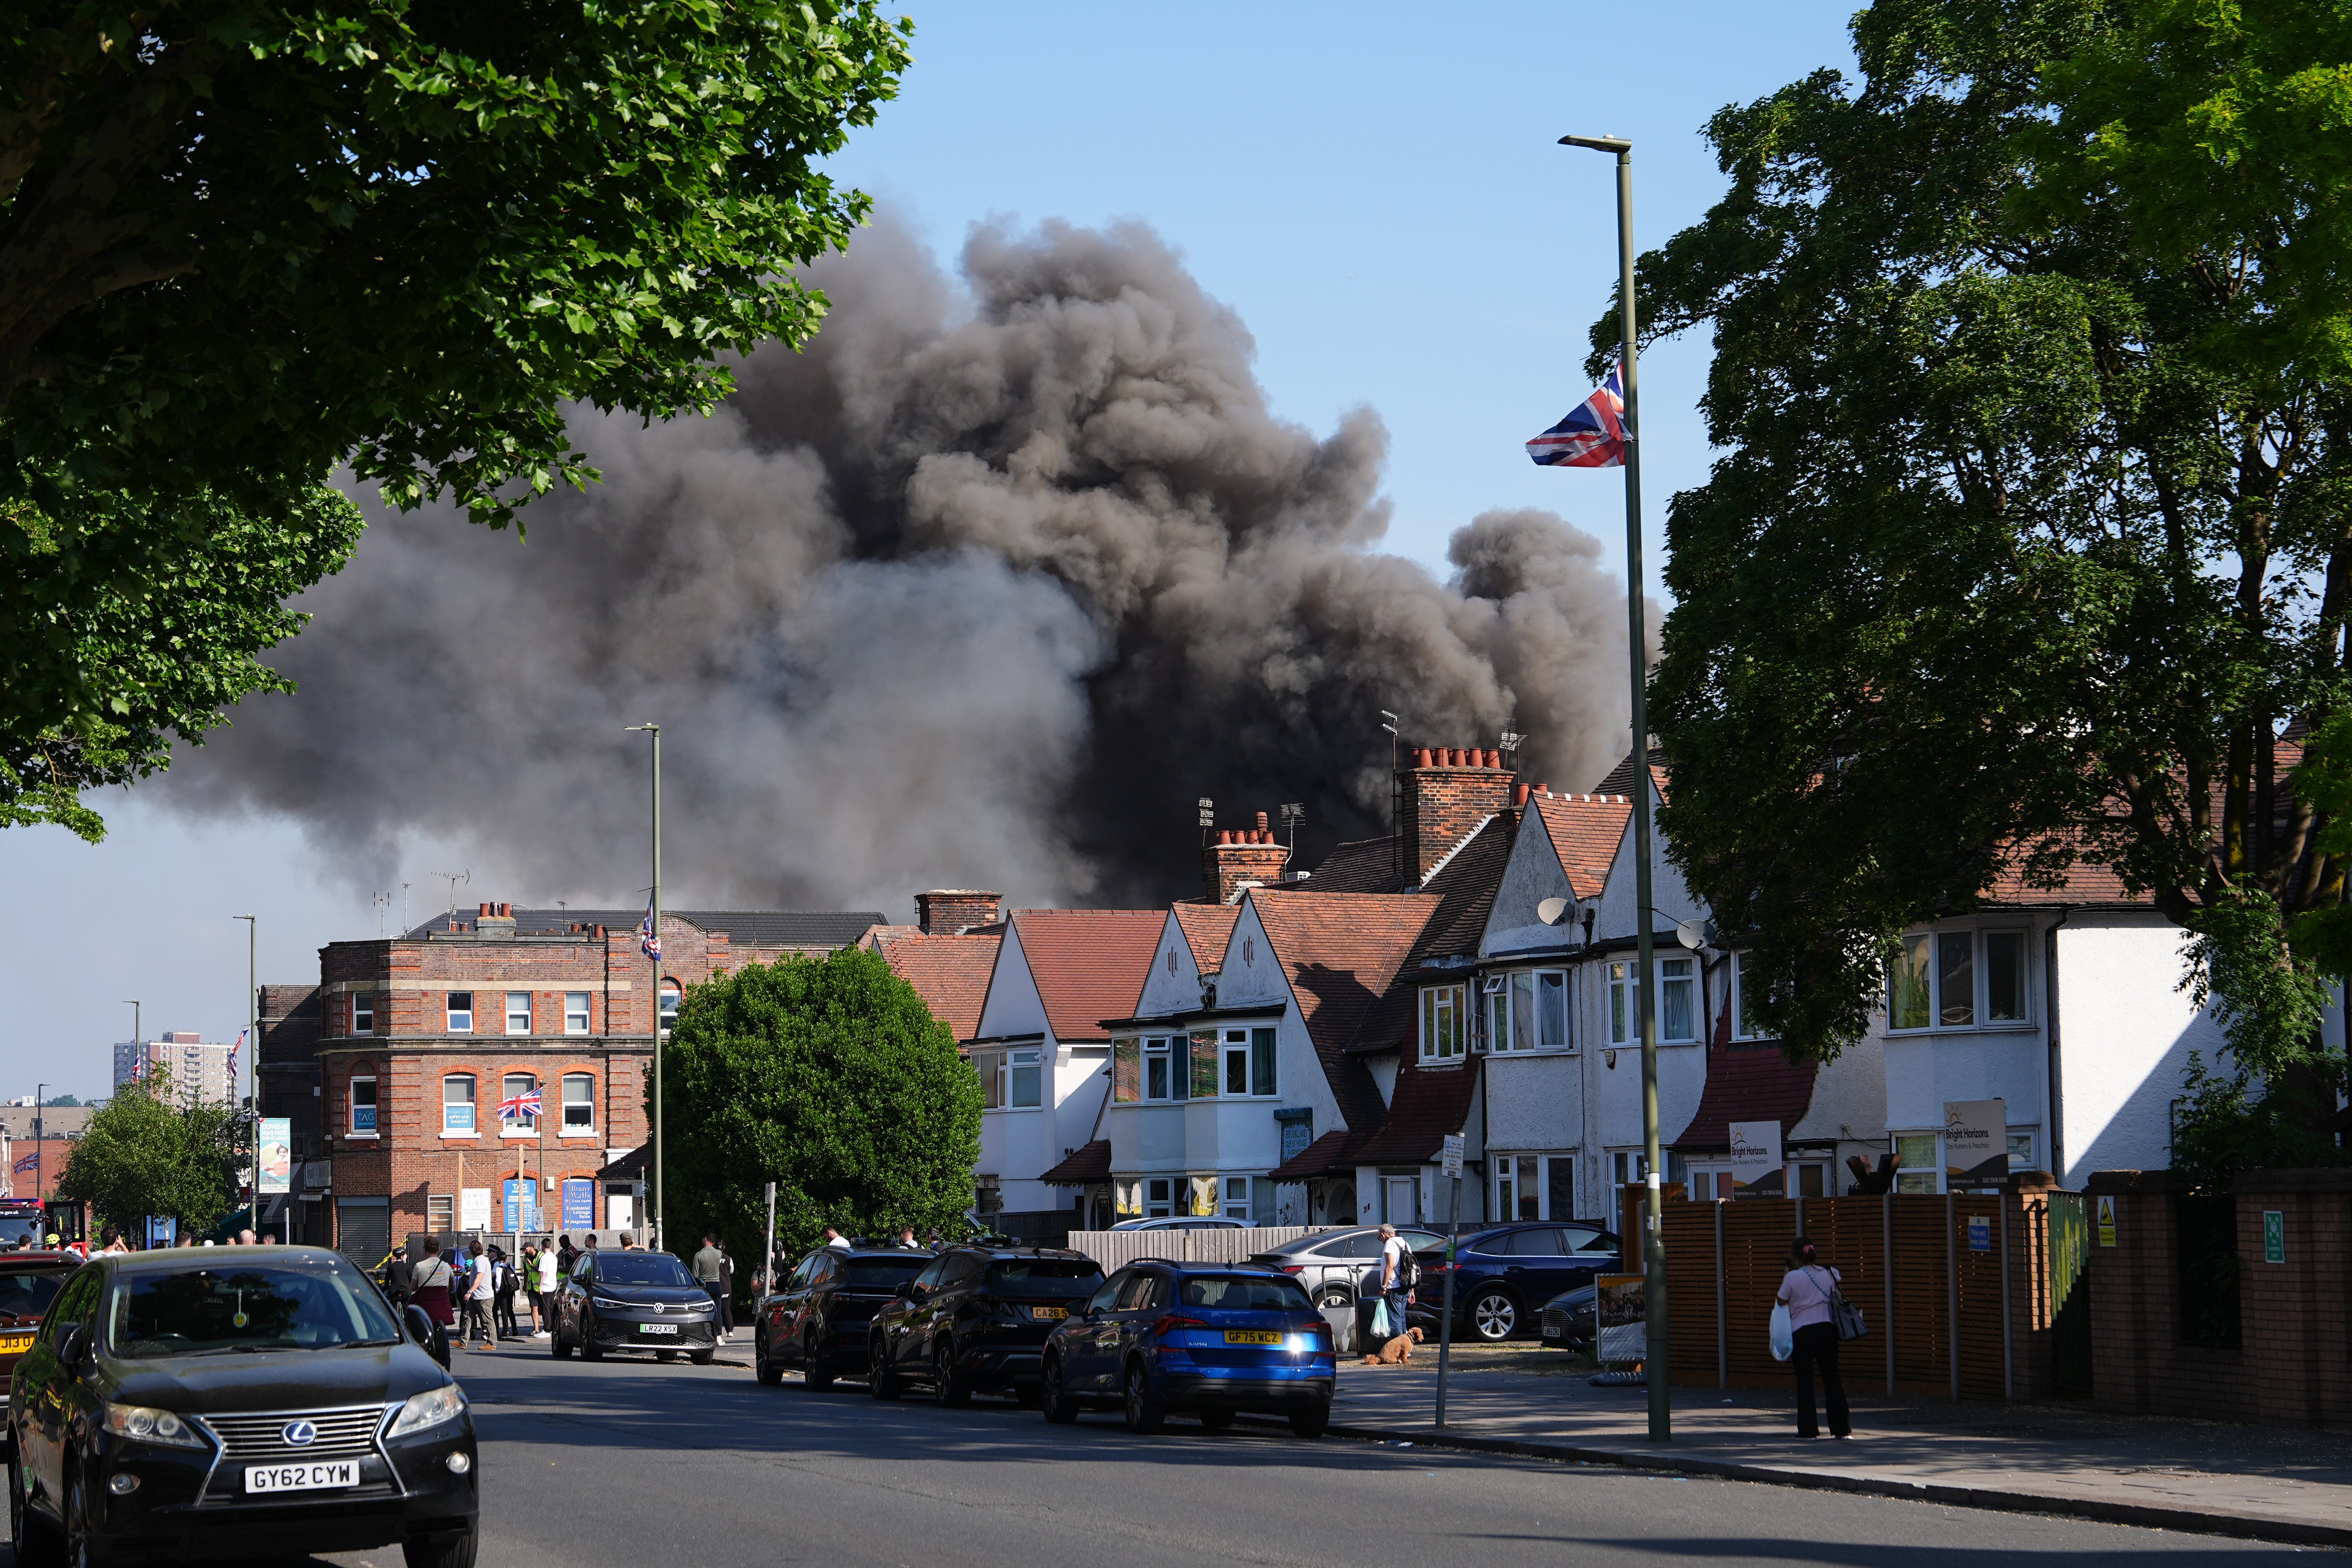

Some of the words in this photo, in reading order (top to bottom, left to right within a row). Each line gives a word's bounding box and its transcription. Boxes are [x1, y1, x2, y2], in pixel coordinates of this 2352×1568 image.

[1286, 1129, 1307, 1139] BROOKLAND
[1946, 1128, 1963, 1142] Bright
[1297, 1139, 1307, 1147] HOUSE
[1732, 1146, 1746, 1158] Bright
[1036, 1309, 1059, 1317] CA26
[1229, 1332, 1255, 1342] GF75
[1258, 1332, 1278, 1343] WCZ
[255, 1468, 305, 1488] GY62
[313, 1464, 350, 1483] CYW
